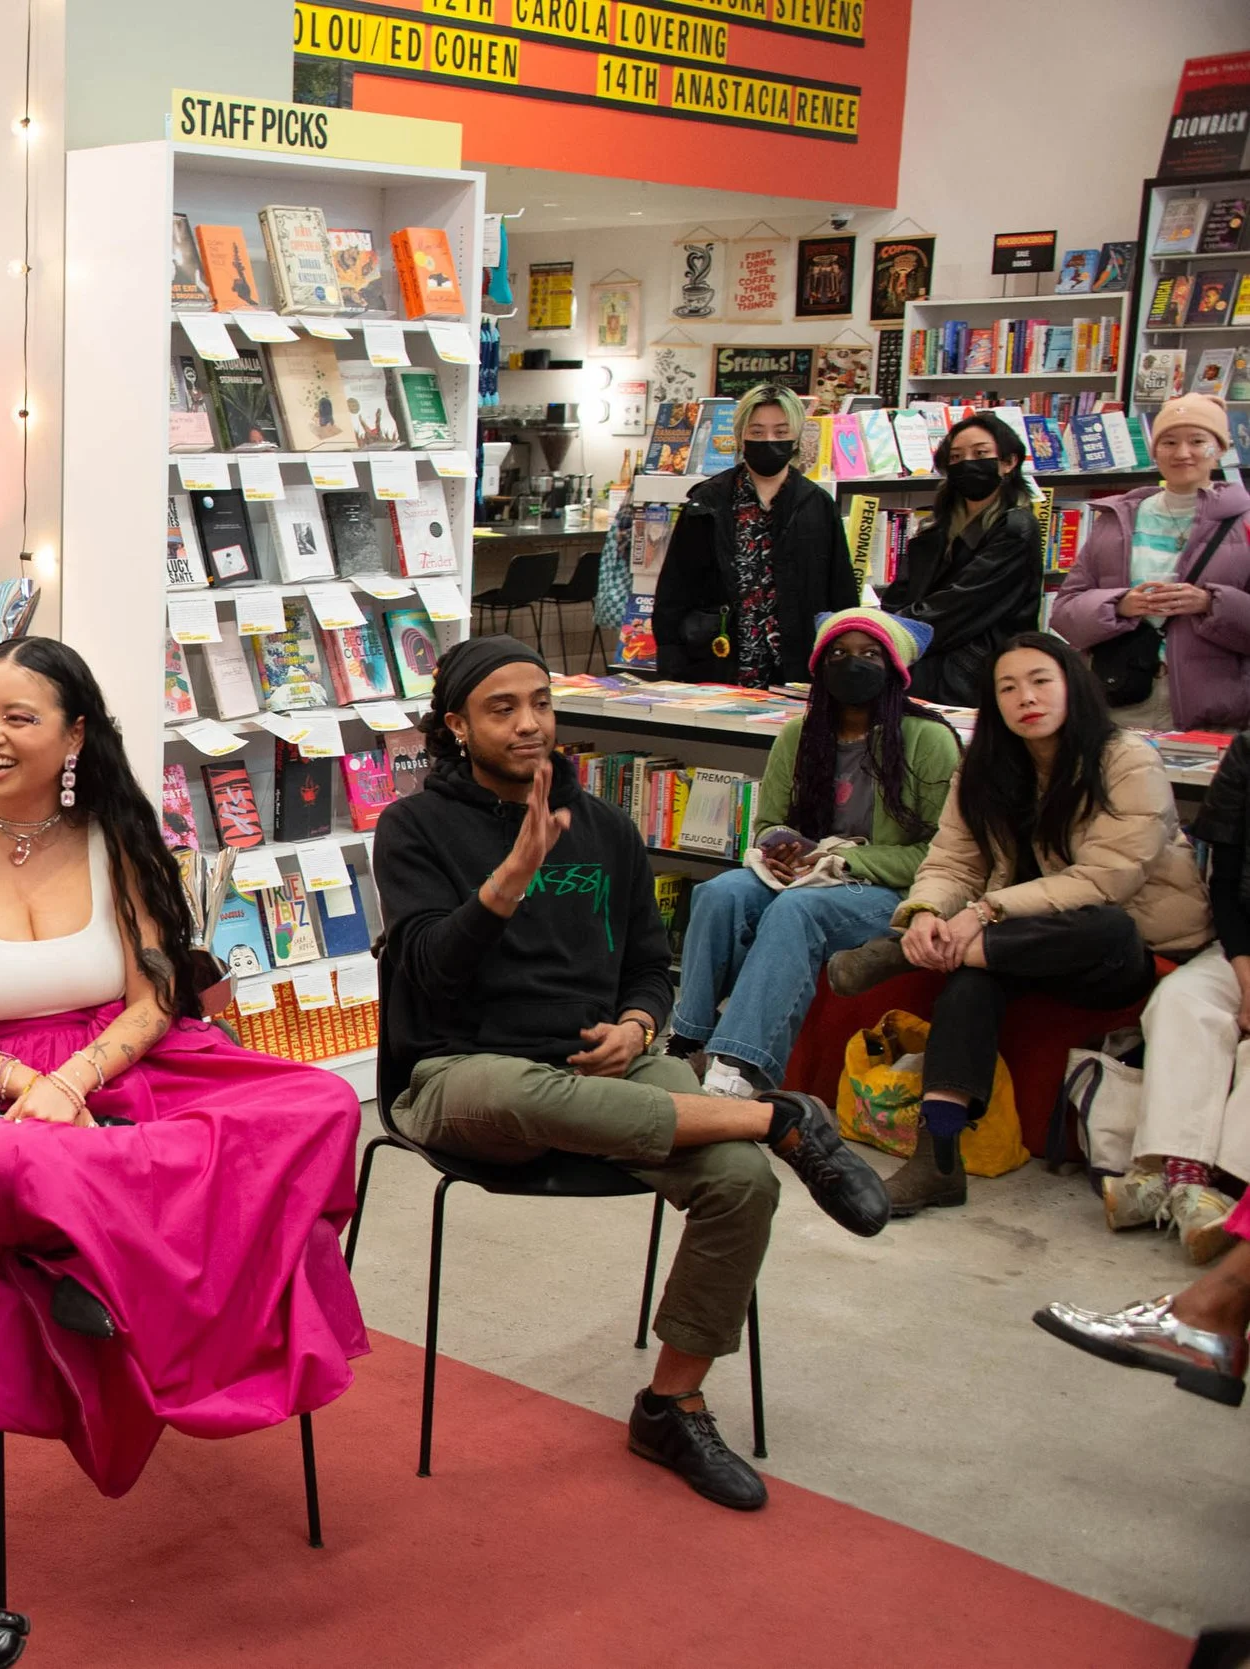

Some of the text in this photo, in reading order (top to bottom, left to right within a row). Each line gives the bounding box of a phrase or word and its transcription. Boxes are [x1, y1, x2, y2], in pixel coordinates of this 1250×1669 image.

[776, 0, 861, 33] STEVENS
[516, 0, 608, 38] CAROLA
[621, 12, 727, 58] LOVERING
[435, 31, 856, 129] COHEN 14TH ANASTACIA RENEE
[181, 97, 327, 150] STAFF PICKS
[1172, 111, 1249, 139] BLOWBACK
[745, 250, 773, 261] FIRST
[746, 258, 777, 269] DRINK
[748, 267, 768, 275] THE
[739, 275, 776, 286] COFFEE
[744, 284, 770, 293] THEN
[740, 294, 754, 302] DO
[758, 292, 777, 300] THE
[737, 300, 774, 311] THINGS
[718, 350, 795, 373] SPECIALS!
[853, 501, 876, 566] PERSONAL
[167, 560, 190, 574] LUCY
[169, 572, 194, 584] SANTE
[395, 758, 429, 772] PURPLE
[680, 832, 724, 846] TEJU COLE
